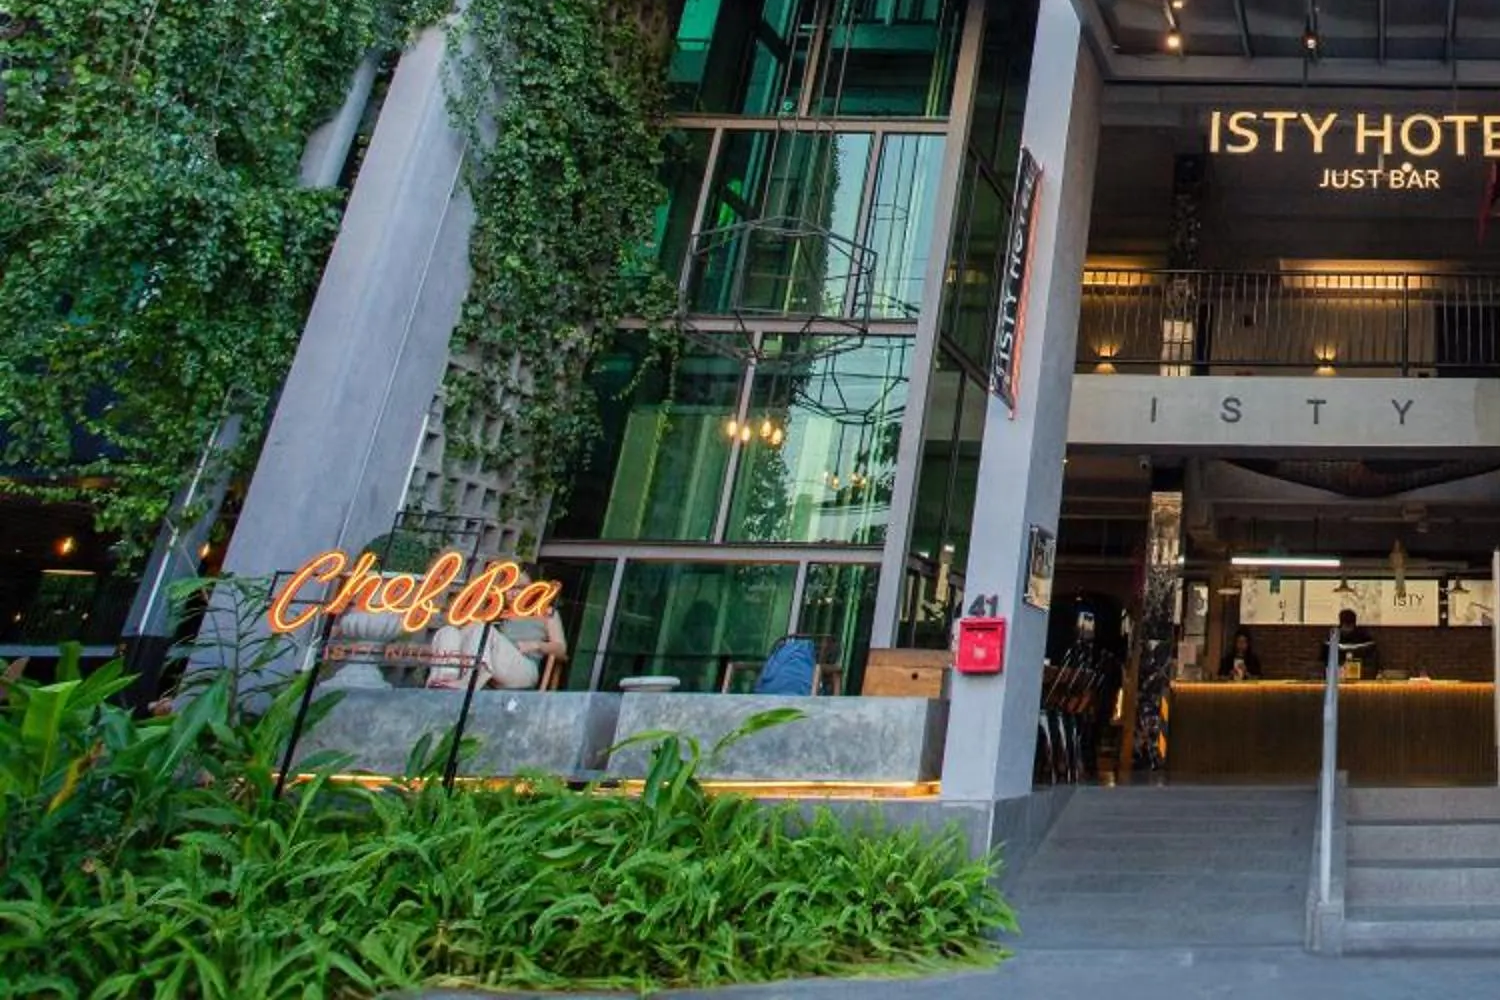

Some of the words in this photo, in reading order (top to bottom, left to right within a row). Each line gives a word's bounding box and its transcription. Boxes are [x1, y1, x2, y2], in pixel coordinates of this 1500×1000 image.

[1209, 110, 1338, 154] ISTY
[1319, 168, 1382, 189] JUST
[1388, 168, 1441, 189] BAR
[1000, 291, 1018, 362] ISTY
[1009, 179, 1034, 279] HOT
[268, 550, 465, 633] Chef
[447, 560, 563, 626] Ba
[967, 593, 999, 618] 41
